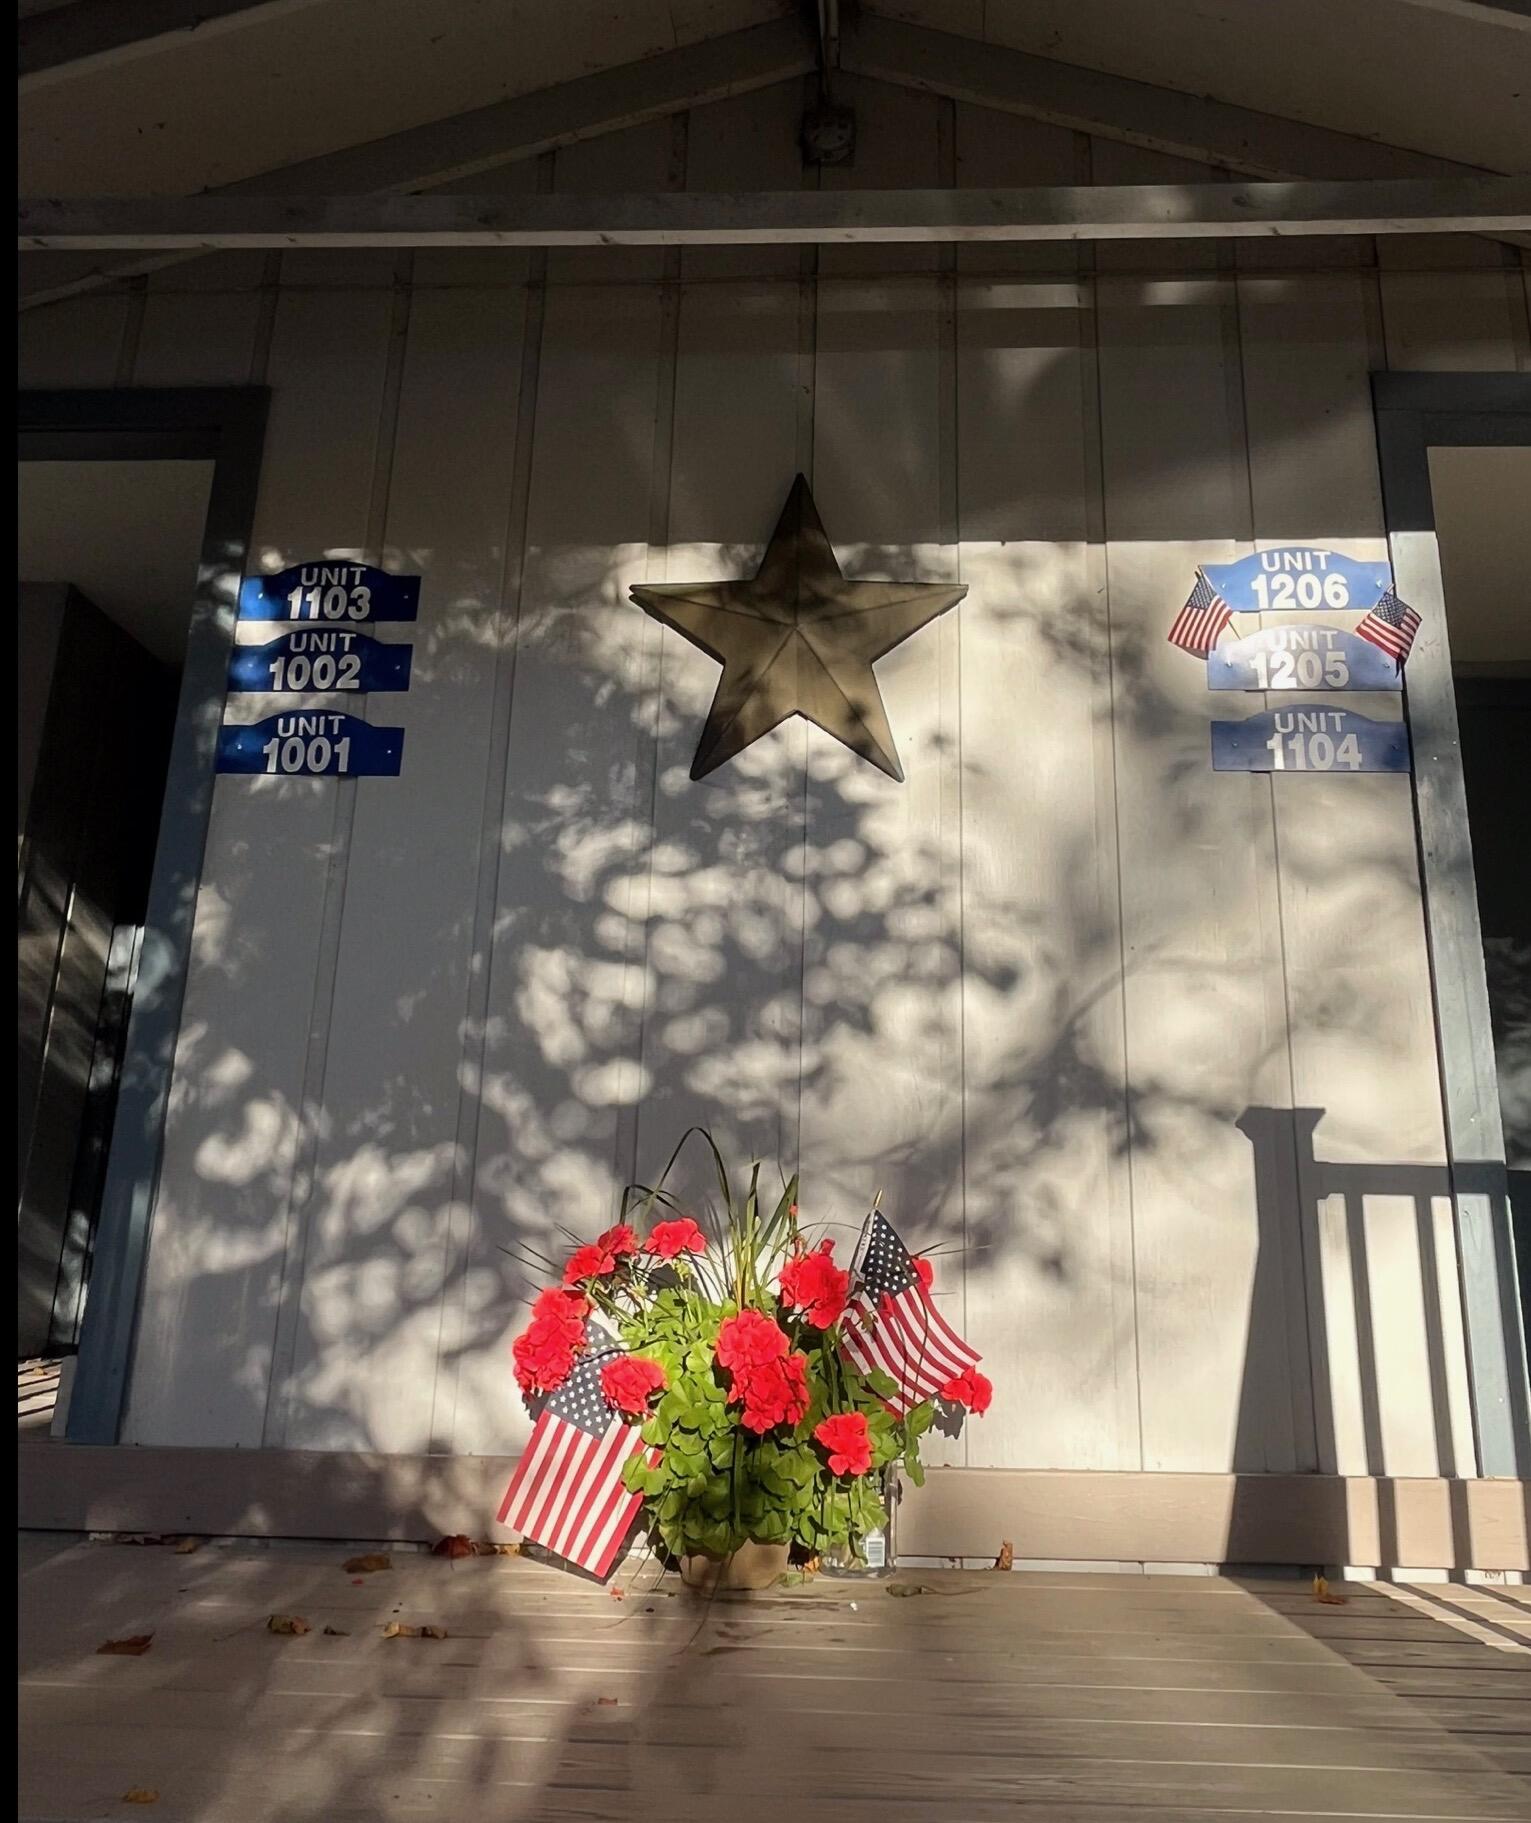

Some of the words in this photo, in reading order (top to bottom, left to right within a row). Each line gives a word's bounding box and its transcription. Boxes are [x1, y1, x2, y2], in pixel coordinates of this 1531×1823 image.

[1261, 551, 1331, 572] UNIT
[301, 567, 366, 586] UNIT
[287, 586, 371, 620] 1103
[1251, 573, 1349, 609] 1206
[289, 633, 356, 652] UNIT
[1267, 630, 1338, 651] UNIT
[269, 654, 361, 690] 1002
[1250, 651, 1349, 689] 1205
[277, 715, 346, 737] UNIT
[1274, 712, 1347, 733] UNIT
[263, 736, 350, 773] 1001
[1266, 733, 1362, 770] 1104
